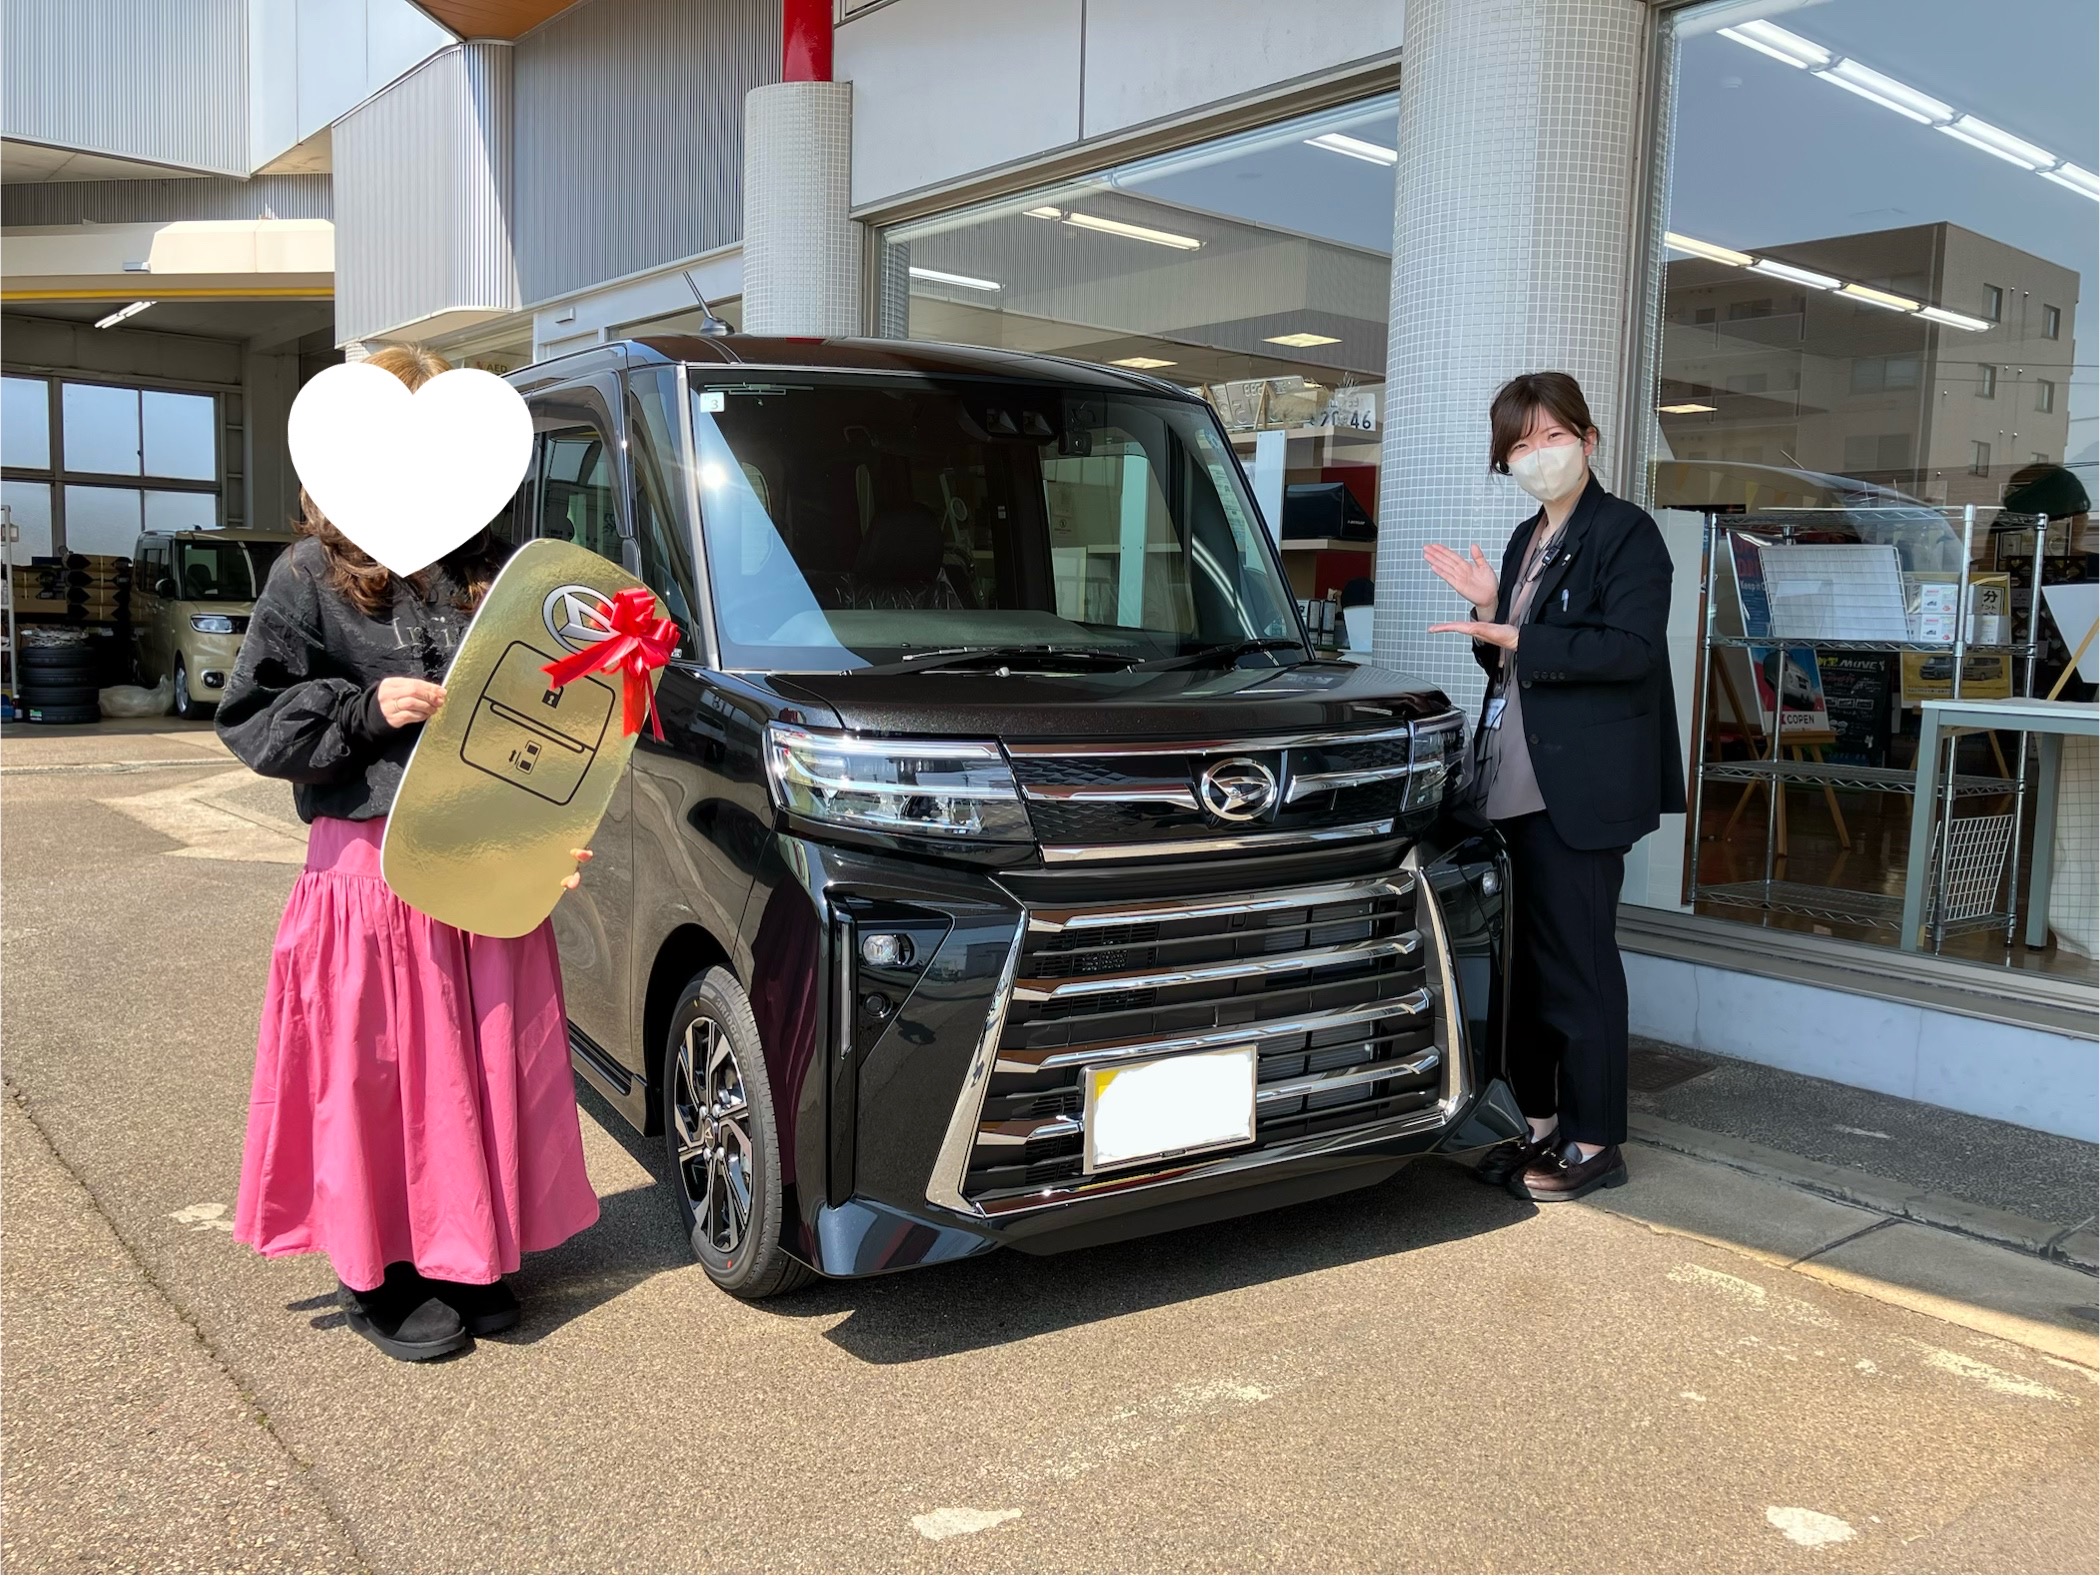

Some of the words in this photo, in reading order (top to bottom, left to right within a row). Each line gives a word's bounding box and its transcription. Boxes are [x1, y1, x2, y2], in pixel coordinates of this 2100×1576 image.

[486, 363, 508, 373] AED
[710, 399, 719, 410] 3
[1786, 714, 1815, 725] COPEN
